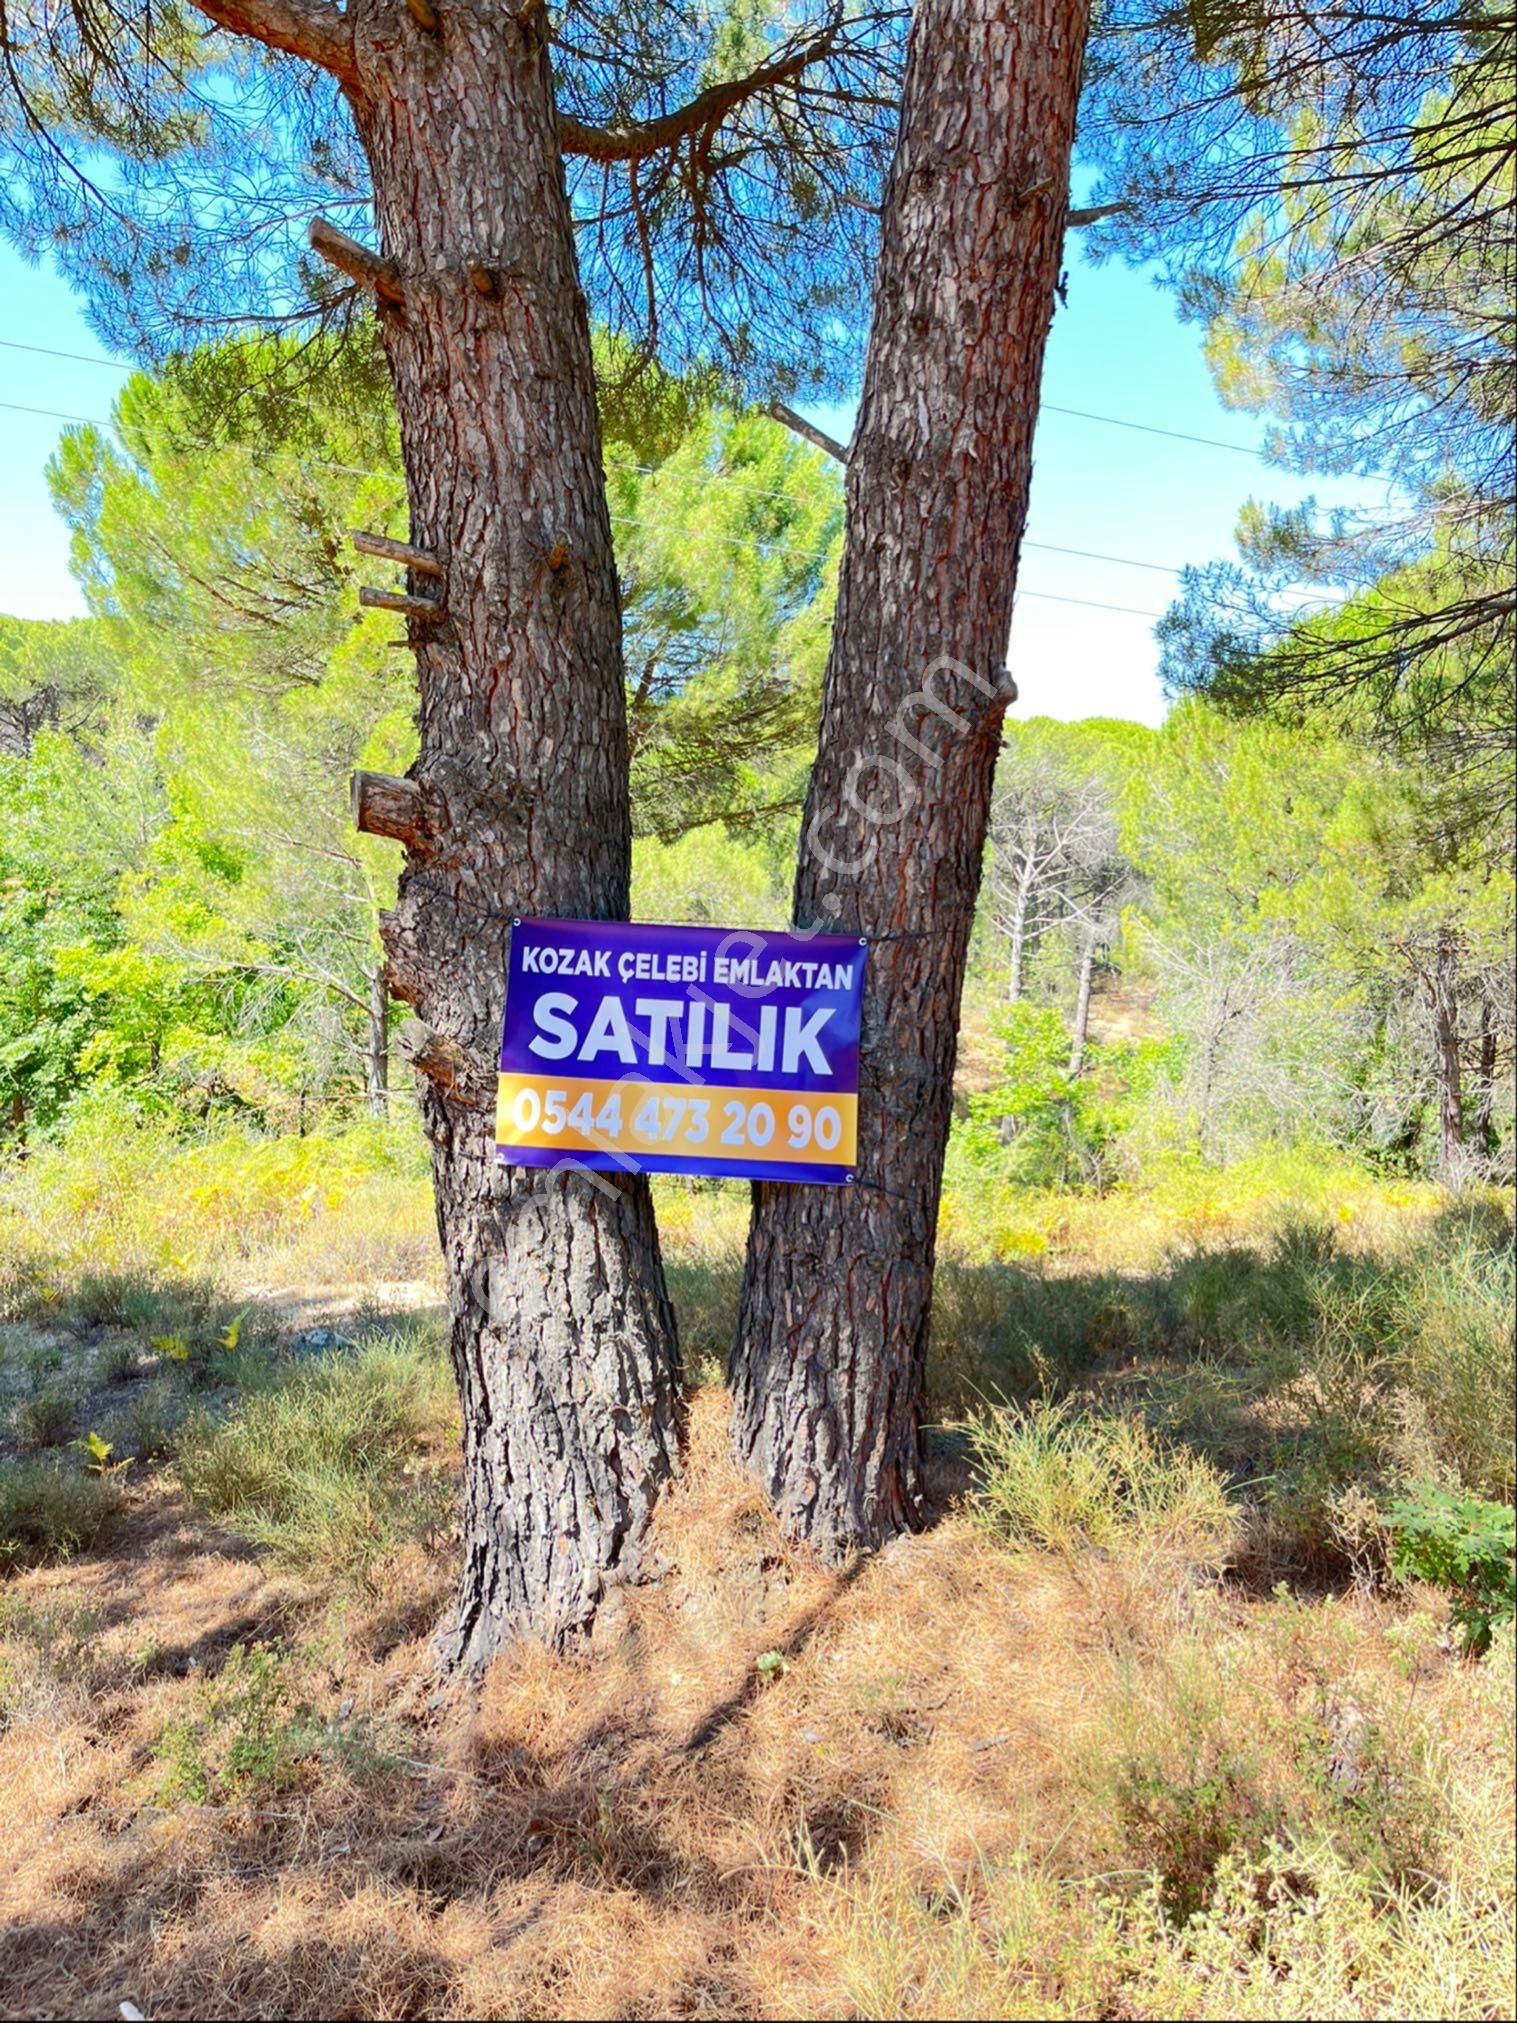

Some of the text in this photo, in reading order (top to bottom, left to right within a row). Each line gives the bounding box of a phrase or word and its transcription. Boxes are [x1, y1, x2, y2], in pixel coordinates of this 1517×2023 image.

[522, 946, 854, 990] KOZAK ÇELEBİ EMLAKTAN
[528, 992, 837, 1076] SATILIK
[512, 1087, 842, 1150] 0544 473 20 90
